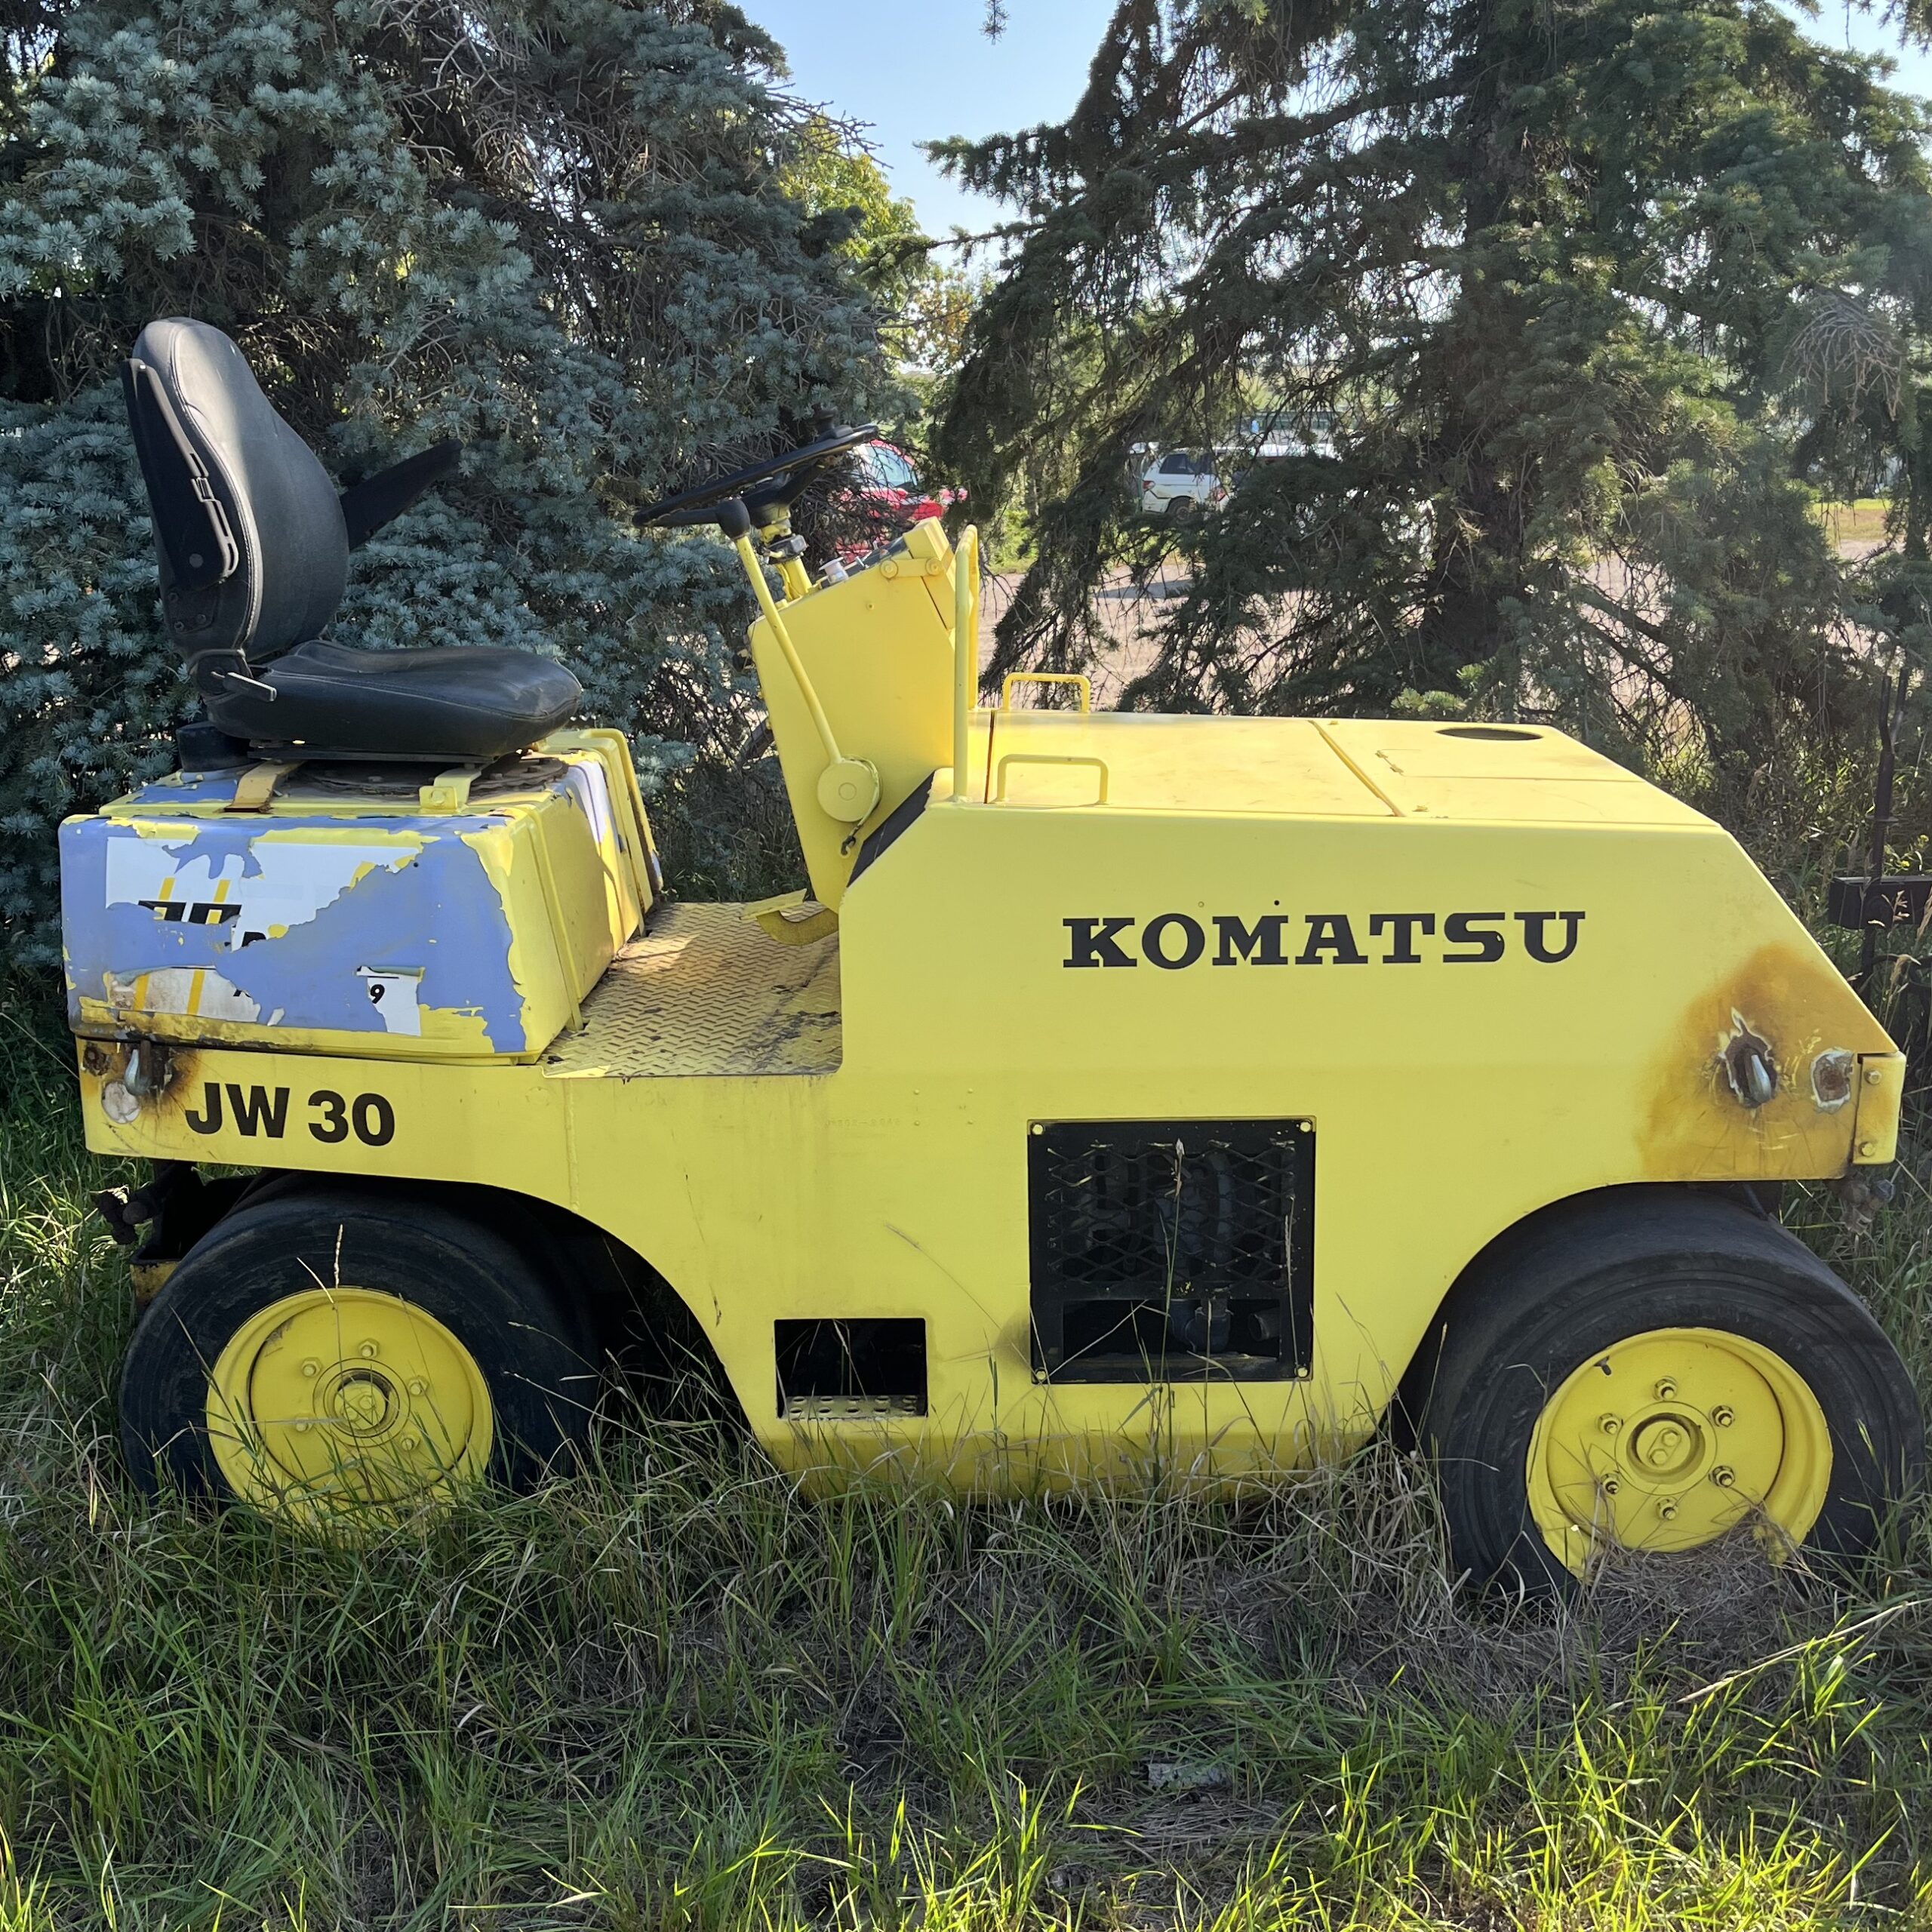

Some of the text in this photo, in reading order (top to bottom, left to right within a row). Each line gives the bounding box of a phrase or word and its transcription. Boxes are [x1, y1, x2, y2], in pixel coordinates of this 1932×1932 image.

[1062, 912, 1586, 970] KOMATSU
[184, 1082, 395, 1147] JW 30
